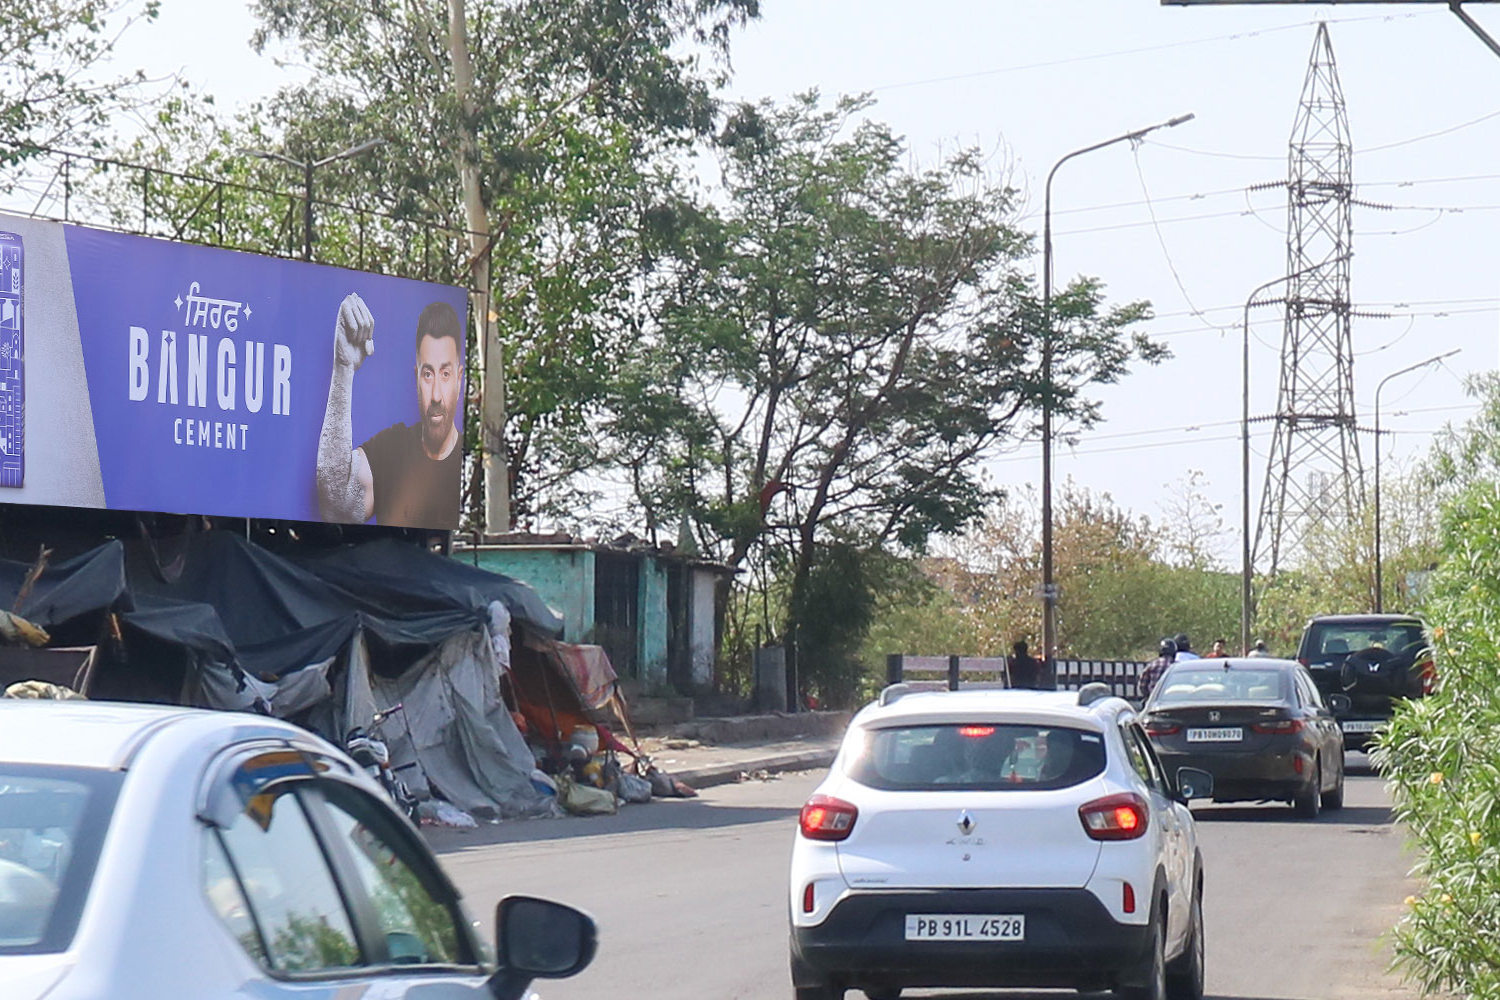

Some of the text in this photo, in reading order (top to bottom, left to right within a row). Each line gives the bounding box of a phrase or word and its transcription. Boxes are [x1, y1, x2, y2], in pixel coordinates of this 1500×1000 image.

[185, 281, 242, 332] ਸਿਰਫ
[129, 326, 292, 416] BANGUR
[174, 418, 248, 450] CEMENT
[916, 919, 1022, 937] PB 91L 4528
